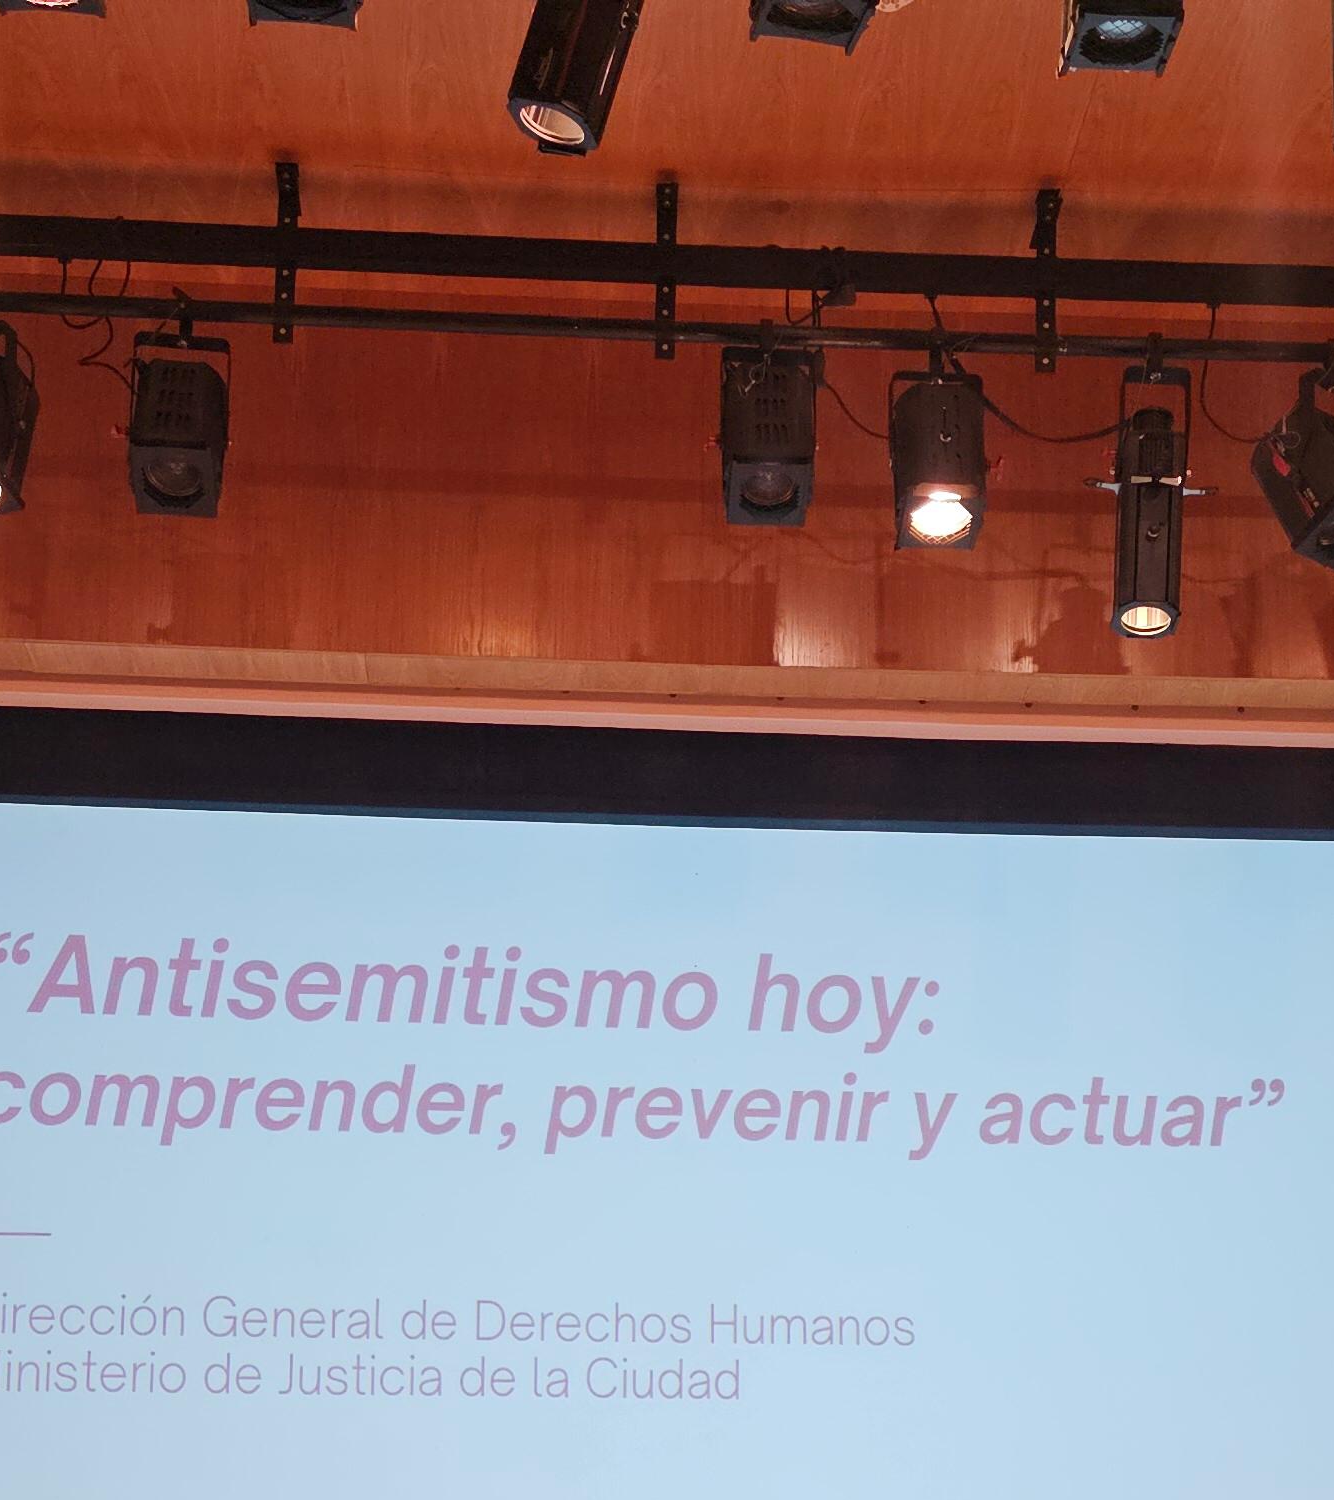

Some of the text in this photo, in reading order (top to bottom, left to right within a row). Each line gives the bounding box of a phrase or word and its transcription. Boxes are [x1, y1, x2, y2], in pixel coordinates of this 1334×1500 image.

[747, 952, 940, 1055] hoy:
[543, 1071, 891, 1155] prevenir
[907, 1091, 960, 1161] y
[978, 1076, 1286, 1148] actuar”
[202, 1295, 385, 1340] General
[400, 1298, 458, 1341] de
[475, 1299, 692, 1345] Derechos
[710, 1302, 916, 1347] Humanos
[203, 1351, 263, 1395] de
[277, 1352, 443, 1397] Justicia
[459, 1355, 516, 1398] de
[533, 1355, 570, 1399] la
[585, 1356, 740, 1401] Ciudad
